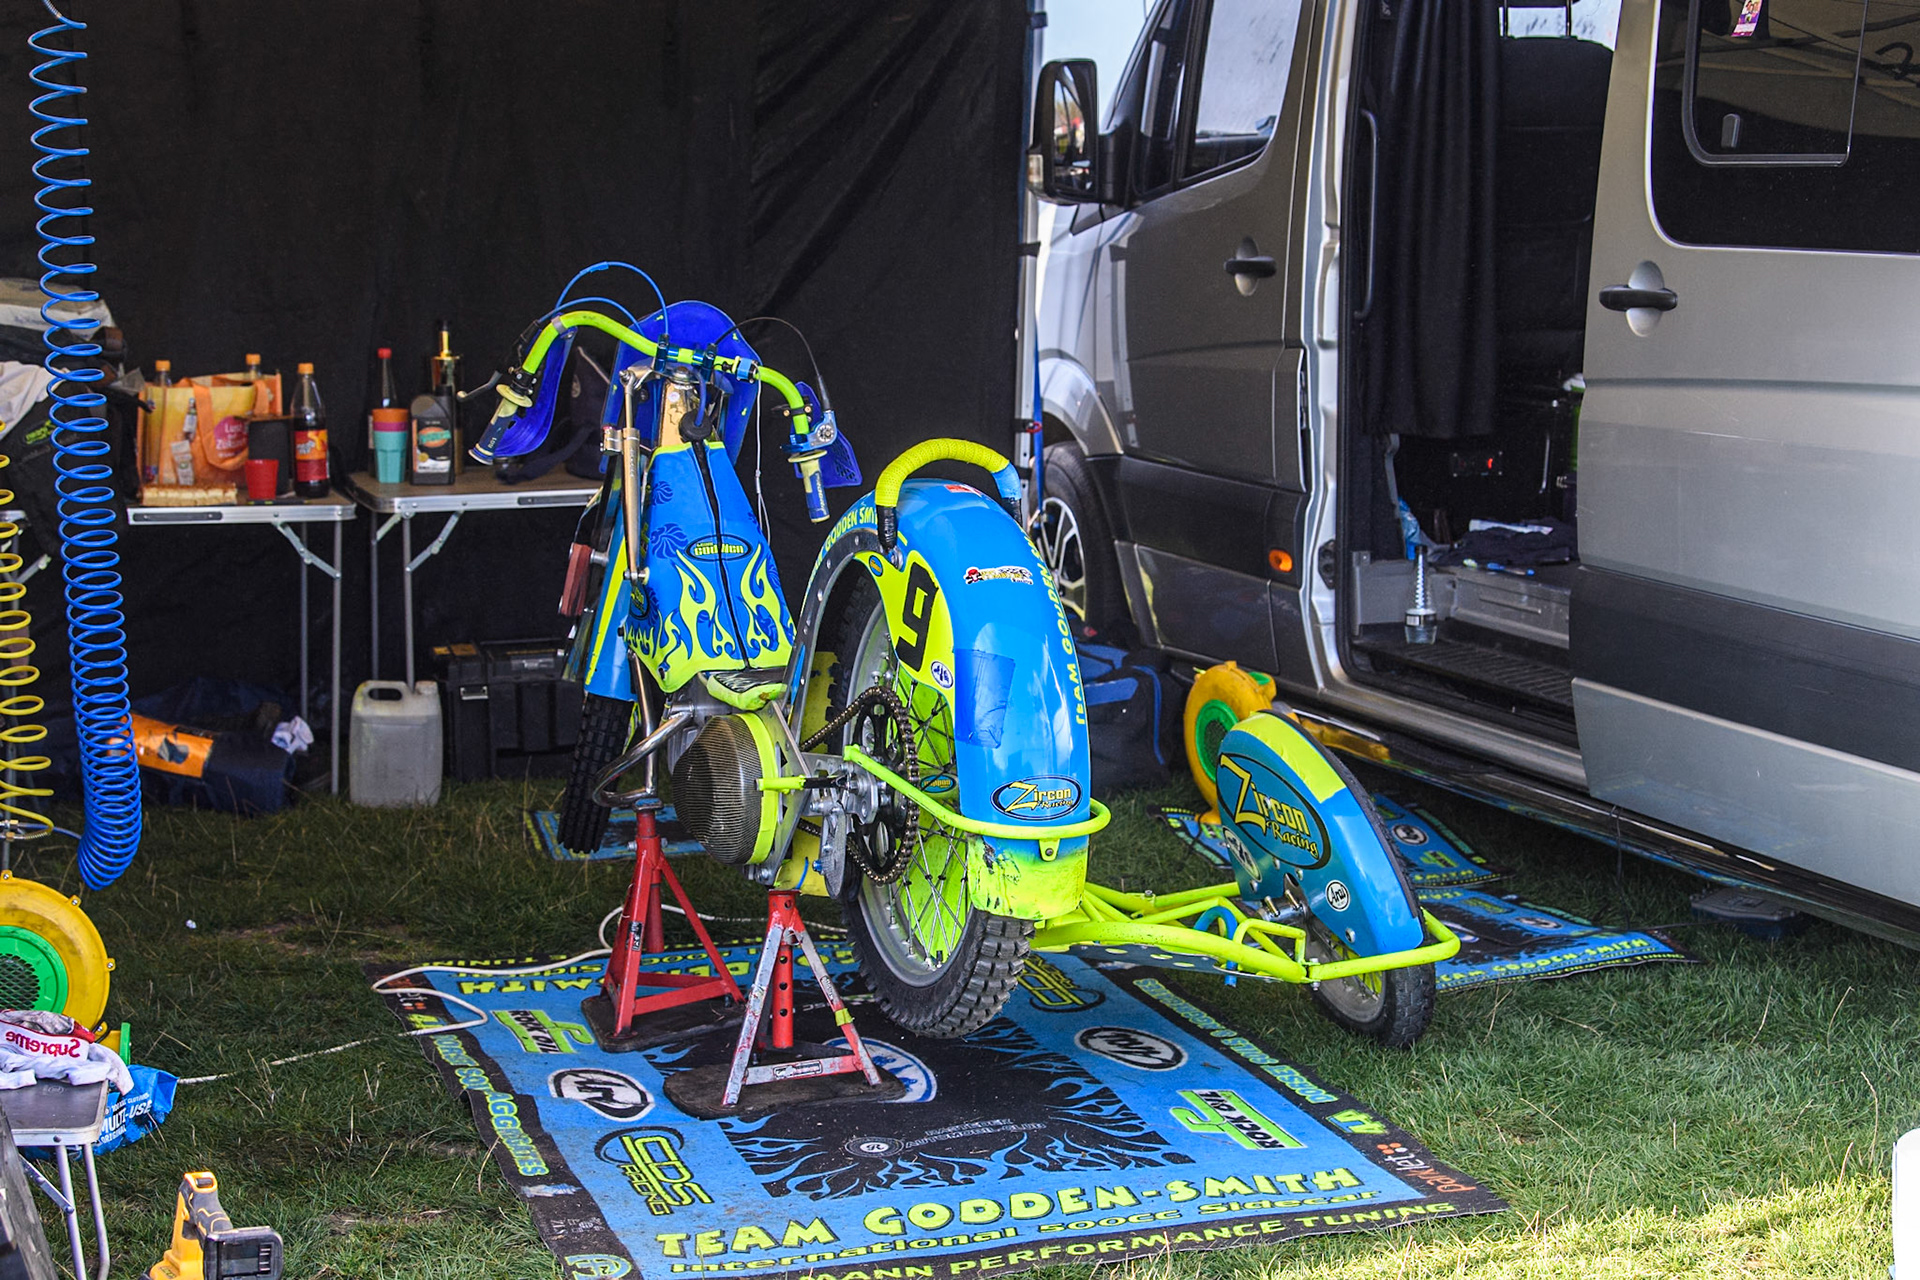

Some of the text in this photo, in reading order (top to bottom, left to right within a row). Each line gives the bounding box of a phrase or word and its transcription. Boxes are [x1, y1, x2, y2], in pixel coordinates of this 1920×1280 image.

[895, 561, 939, 669] 9
[1069, 664, 1086, 725] TEAM
[1004, 781, 1072, 812] Zircon
[1220, 754, 1311, 837] Zircon
[1266, 821, 1319, 860] Racing
[1229, 1113, 1286, 1149] ROCK
[656, 1167, 1366, 1259] TEAM GODDEN-SMITH
[951, 1219, 1286, 1275] PERFORMANCE
[1297, 1202, 1457, 1227] TUNING
